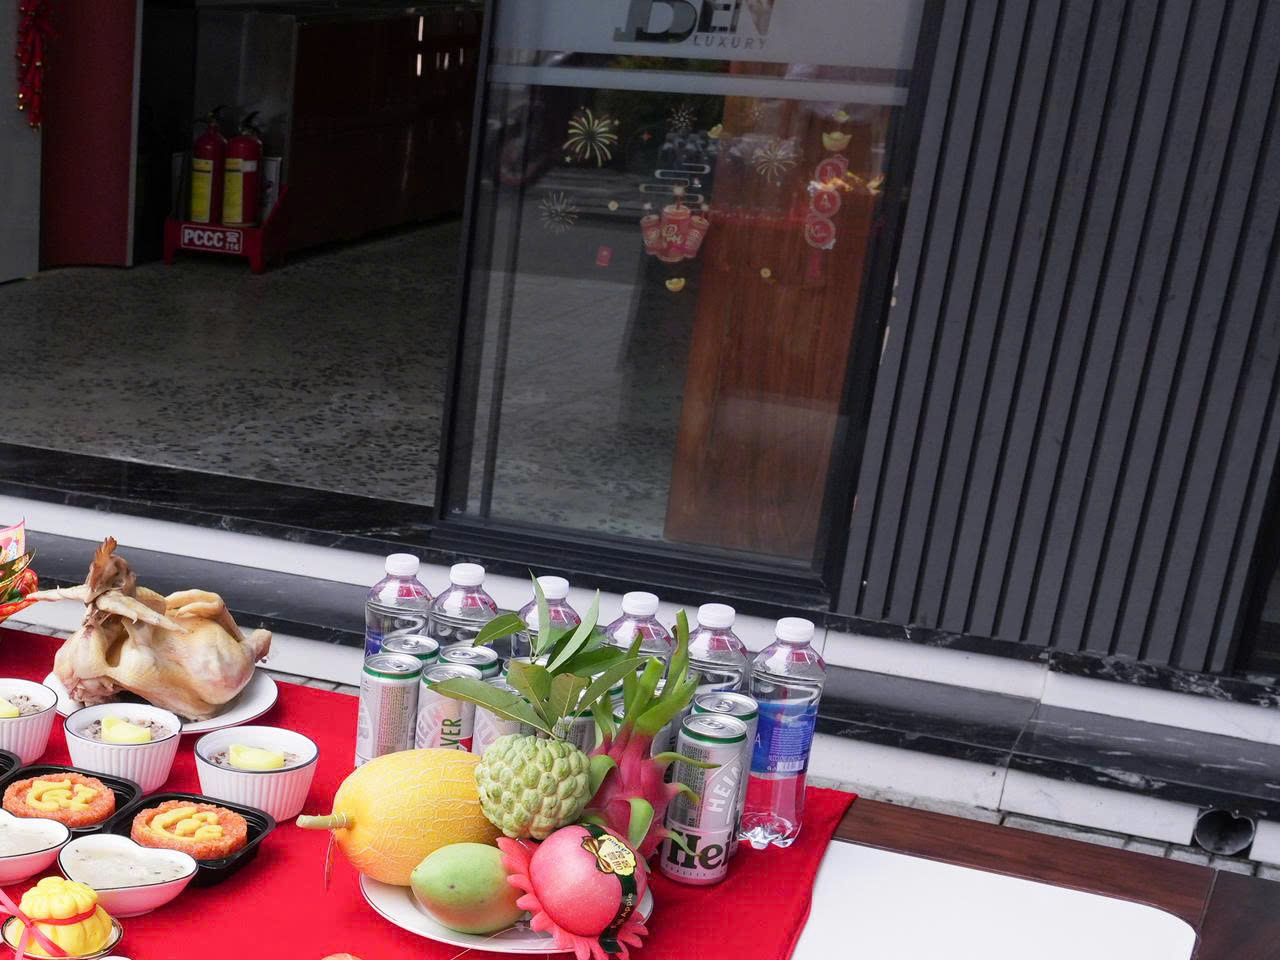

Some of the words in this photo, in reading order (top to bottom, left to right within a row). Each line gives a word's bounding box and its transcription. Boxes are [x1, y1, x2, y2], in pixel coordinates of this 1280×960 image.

[694, 35, 768, 50] LUXURY
[183, 229, 224, 248] PCCC
[440, 718, 462, 749] VER
